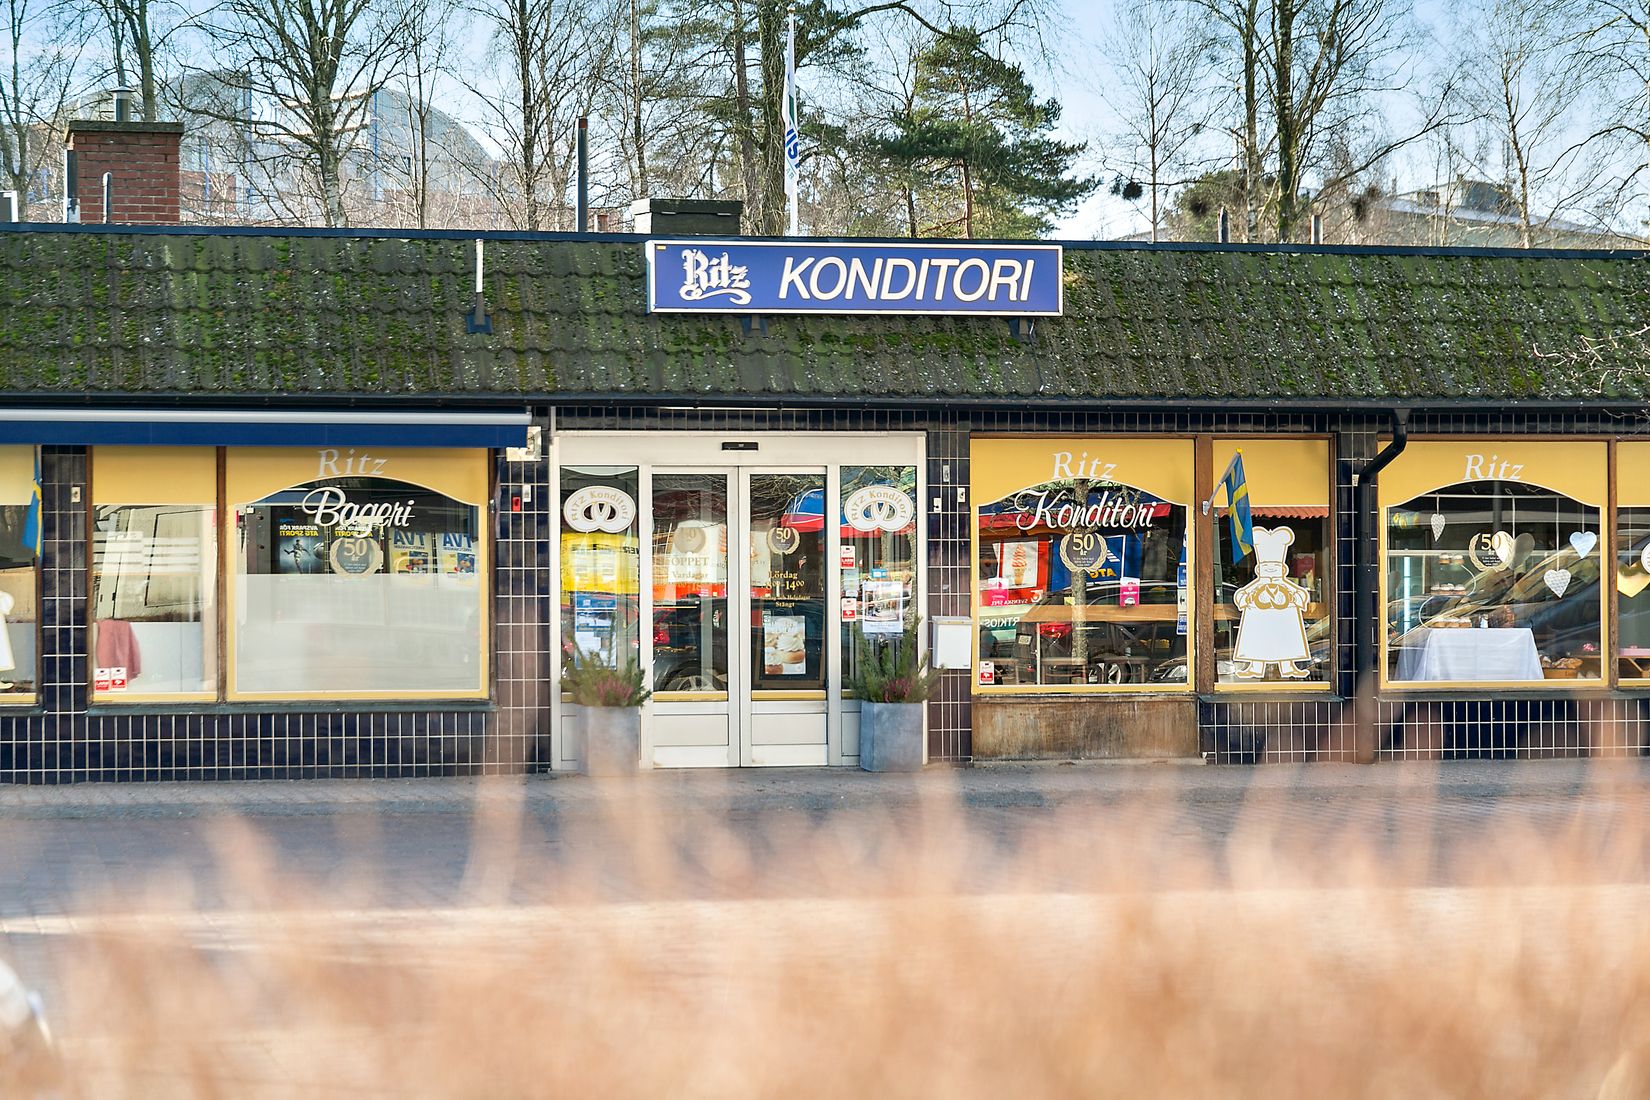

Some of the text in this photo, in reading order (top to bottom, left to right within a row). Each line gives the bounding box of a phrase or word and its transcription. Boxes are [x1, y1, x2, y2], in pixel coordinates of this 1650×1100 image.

[679, 249, 1035, 306] Ritz KONDITORI
[315, 448, 388, 478] Ritz
[1052, 451, 1118, 479] Ritz
[1463, 453, 1524, 481] Ritz
[302, 487, 416, 539] Bageri
[589, 490, 630, 521] Konditori
[851, 490, 908, 521] RITZ Konditori
[1014, 489, 1158, 531] Konditori
[344, 539, 368, 556] 50
[776, 527, 791, 540] 50
[1072, 533, 1095, 551] 50
[1481, 533, 1501, 550] 50
[768, 570, 798, 579] Lördag
